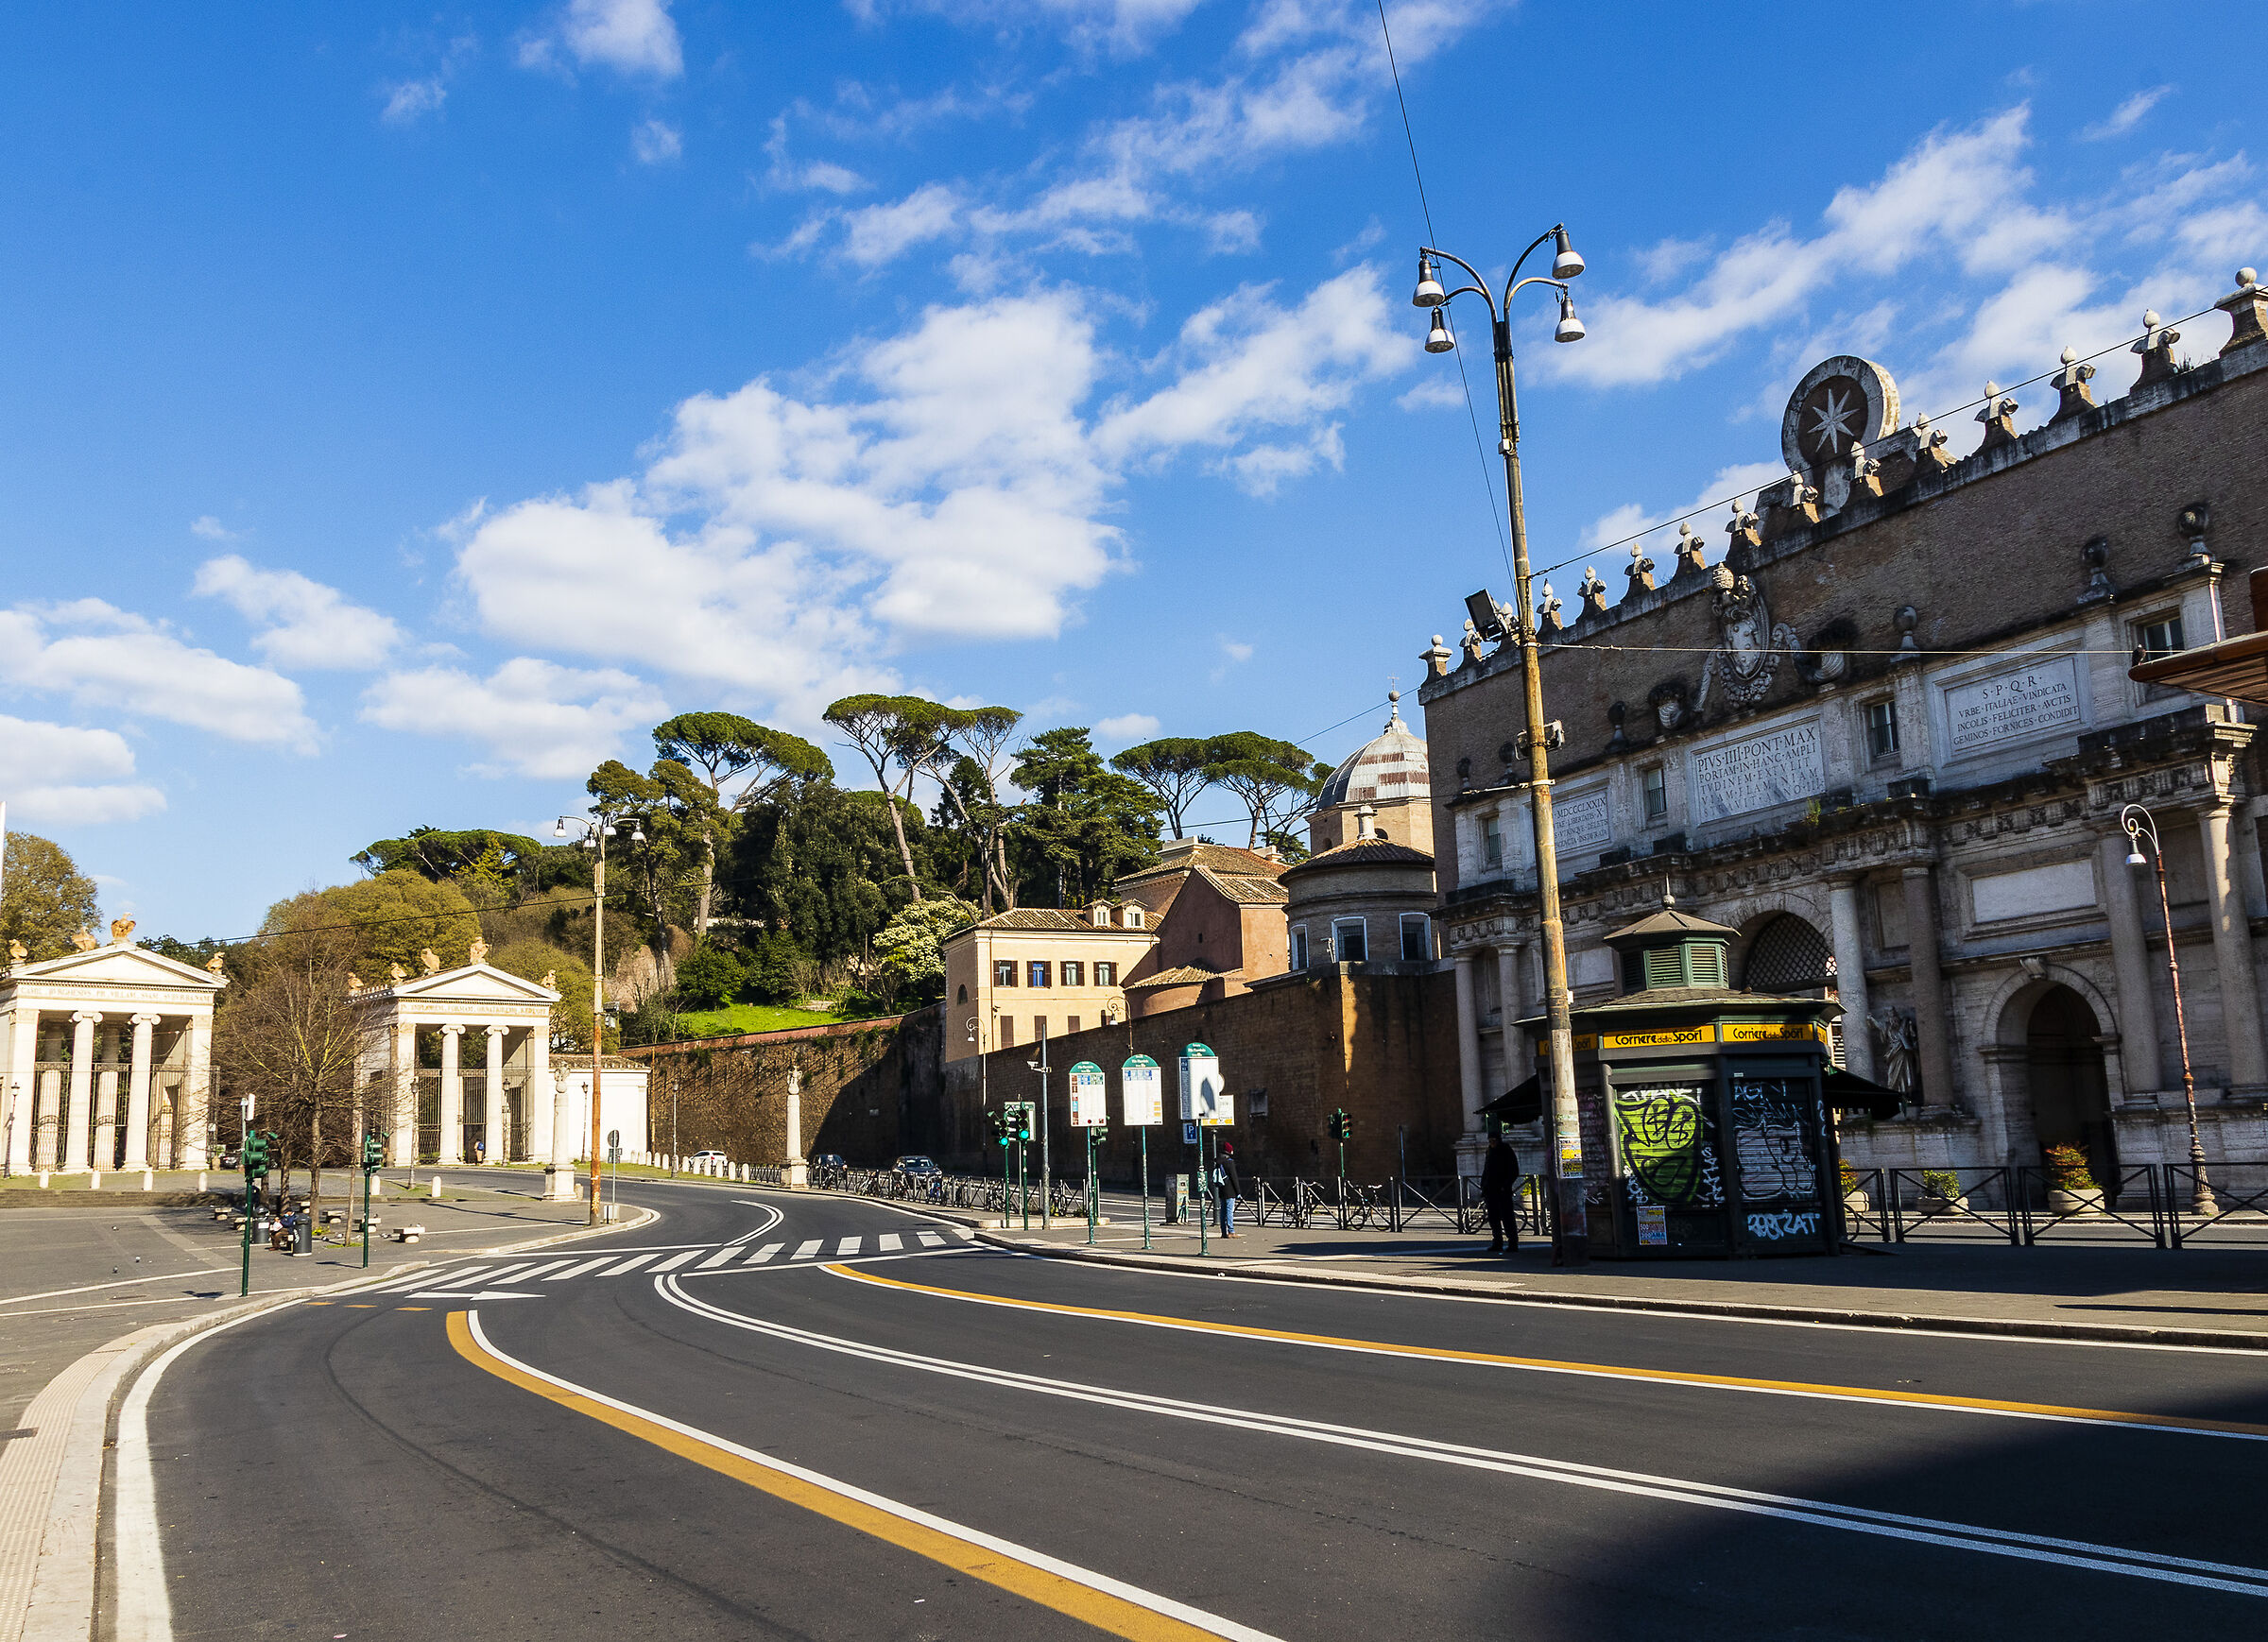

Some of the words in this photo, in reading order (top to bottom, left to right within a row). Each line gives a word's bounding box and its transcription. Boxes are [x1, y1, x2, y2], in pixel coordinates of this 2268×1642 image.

[1957, 716, 1988, 732] INCOLIS
[1992, 704, 2037, 723] FELICITER
[2042, 694, 2071, 710] AVCTIS
[1958, 706, 1981, 718] VRBE
[1984, 696, 2019, 711] ITALIAE
[2022, 682, 2067, 701] VINDICATA
[1953, 728, 1988, 745] GEMINOS
[1992, 717, 2035, 735] FORNICES
[2037, 705, 2079, 724] CONDIDIT
[1697, 755, 1722, 772] PIVS
[1725, 746, 1742, 765] IIII
[1744, 736, 1781, 759] PONT
[1783, 727, 1815, 748] MAX
[1699, 764, 1737, 783] PORTAM
[1739, 761, 1750, 773] IN
[1753, 753, 1781, 769] HANC
[1785, 743, 1816, 760] AMPLI
[1700, 773, 1752, 795] TVDINEM
[1556, 796, 1606, 818] MDCCCLXXIX
[1615, 1034, 1658, 1045] Corriere
[1673, 1030, 1702, 1043] Sport
[1733, 1028, 1767, 1040] Corriere
[1780, 1028, 1804, 1040] Sport
